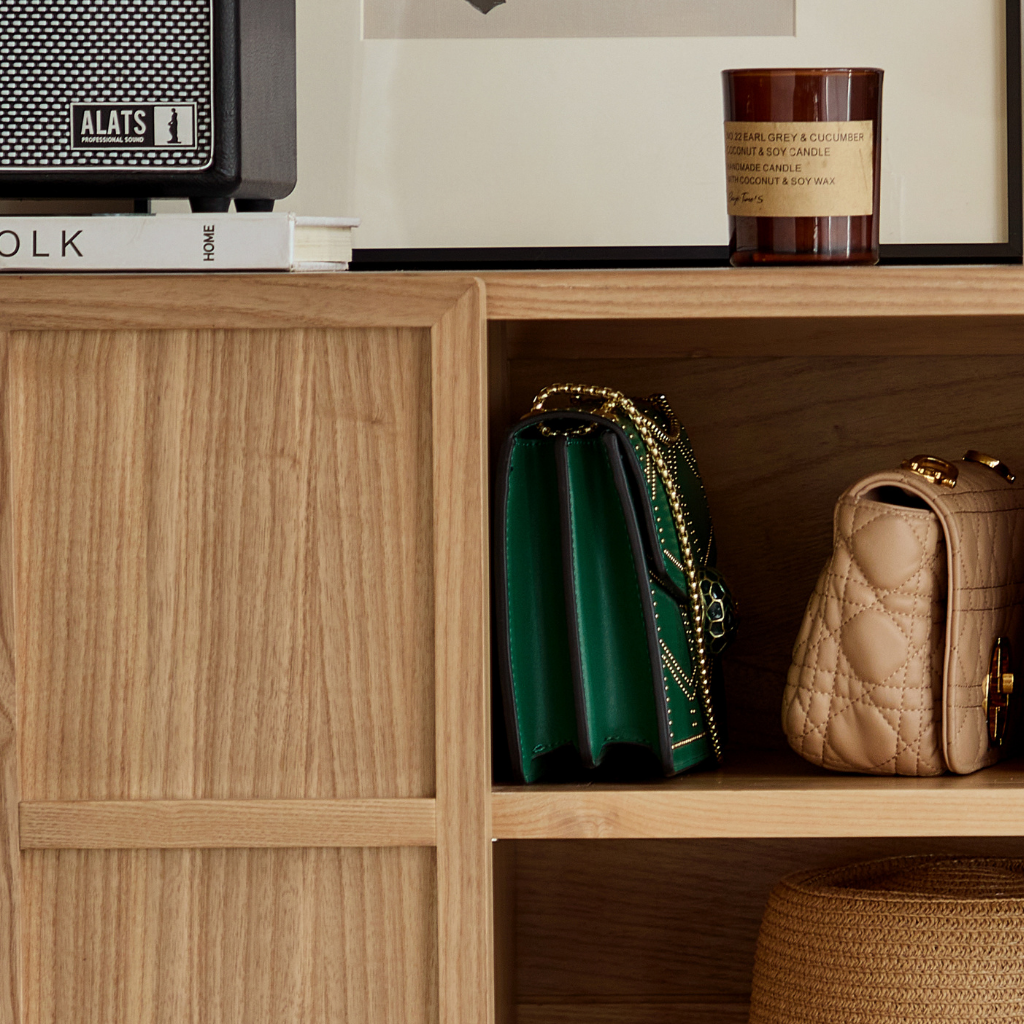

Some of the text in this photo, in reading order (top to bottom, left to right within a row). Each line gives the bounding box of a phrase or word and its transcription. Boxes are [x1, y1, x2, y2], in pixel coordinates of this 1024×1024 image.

[81, 110, 147, 135] ALATS
[743, 132, 766, 142] EARL
[768, 133, 798, 142] GREY
[800, 133, 807, 142] &
[810, 132, 865, 142] CUCUMBER
[758, 147, 765, 156] &
[766, 147, 787, 157] SOY
[789, 147, 831, 157] CANDLE
[762, 163, 802, 173] CANDLE
[739, 175, 780, 185] COCONUT
[782, 176, 789, 186] &
[791, 176, 812, 186] SOY
[814, 176, 836, 186] WAX
[0, 229, 84, 257] OLK
[203, 224, 216, 261] HOME
